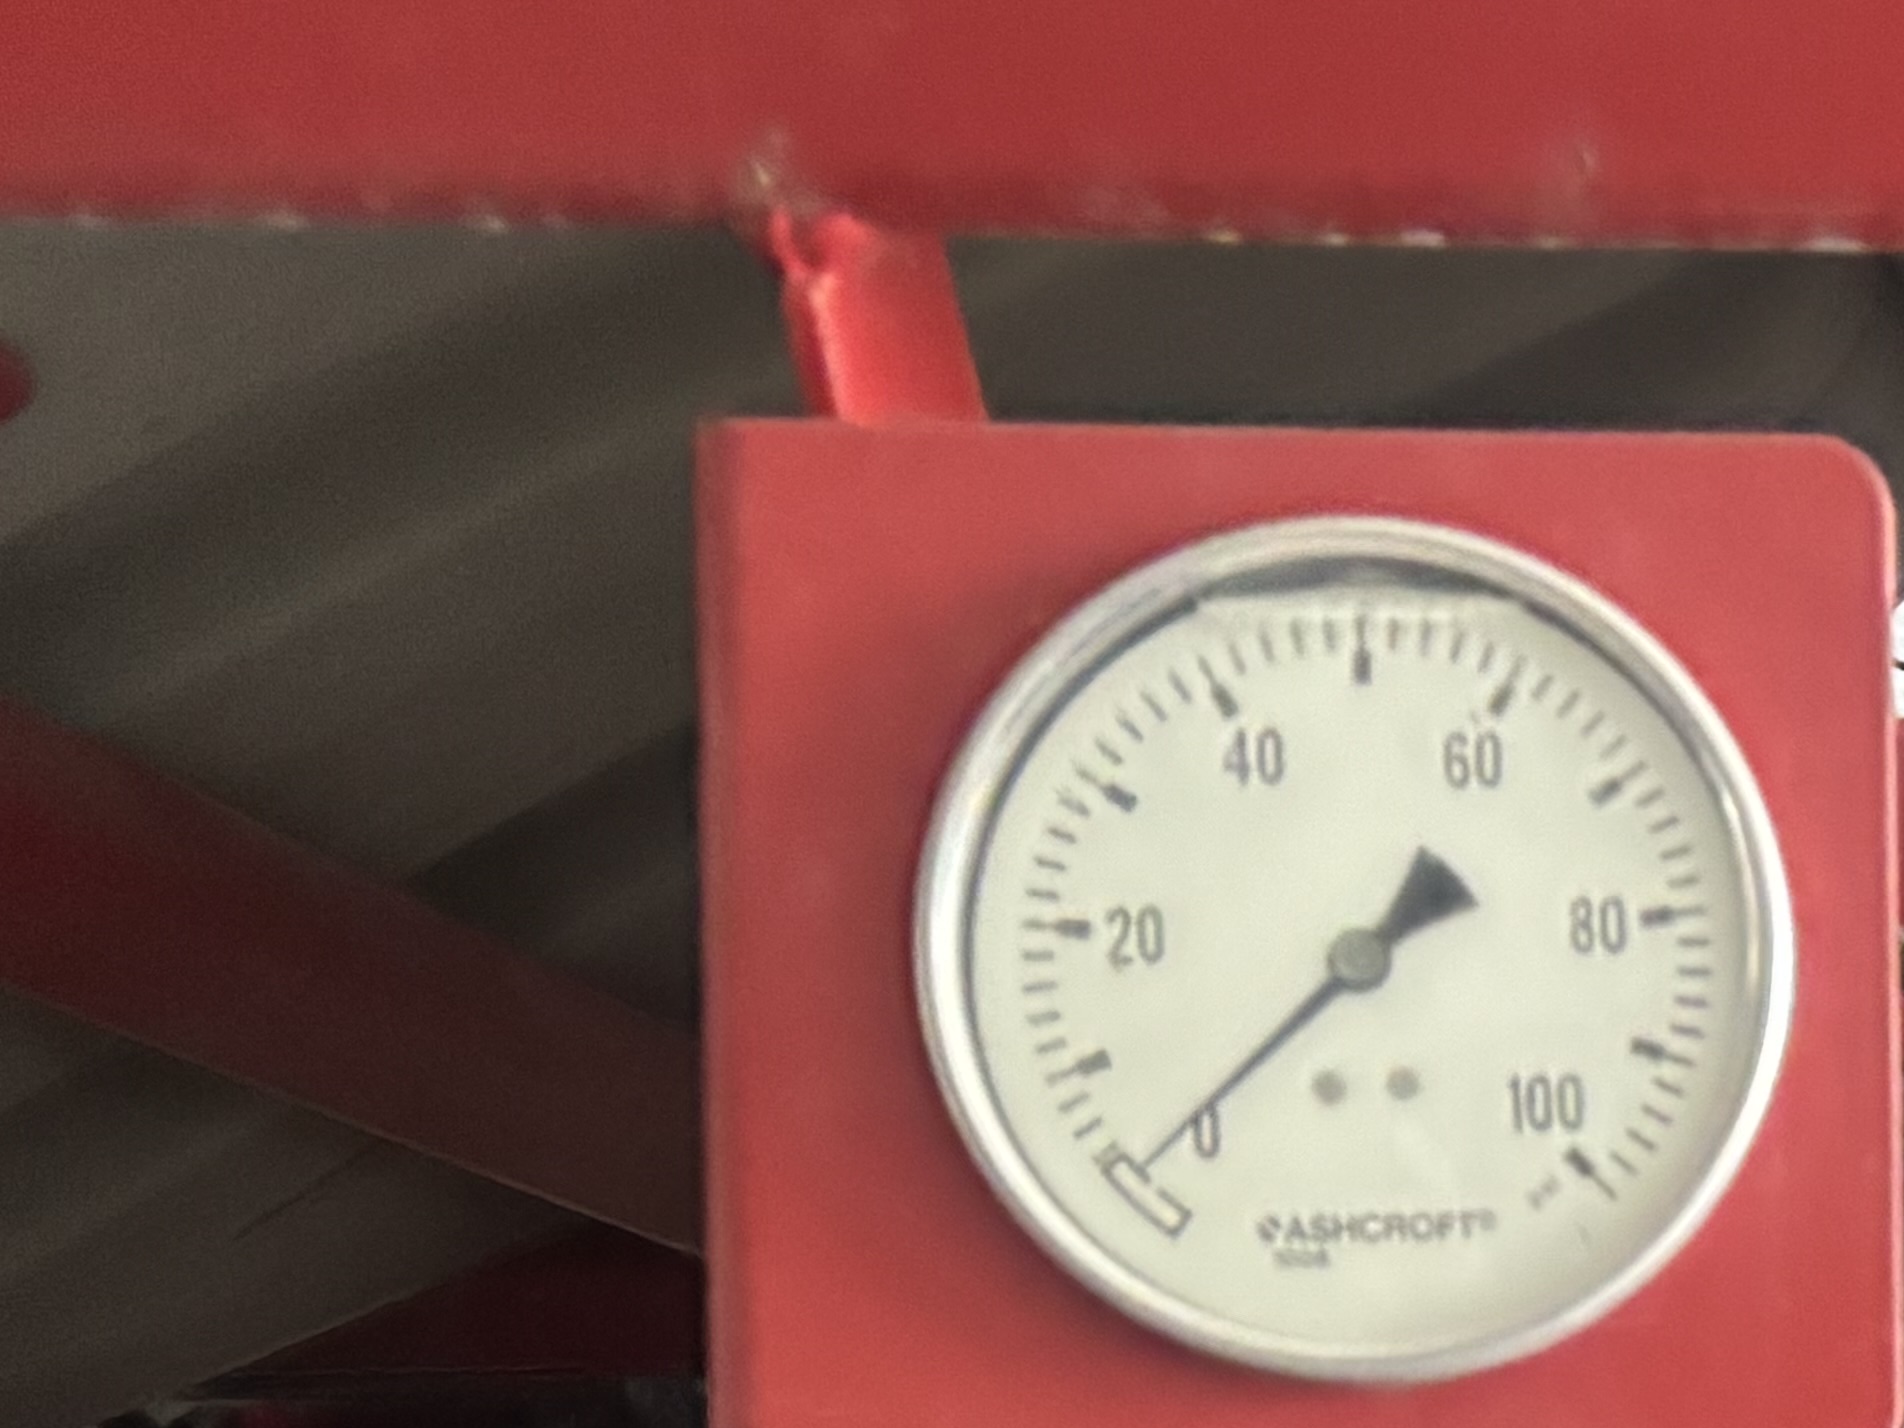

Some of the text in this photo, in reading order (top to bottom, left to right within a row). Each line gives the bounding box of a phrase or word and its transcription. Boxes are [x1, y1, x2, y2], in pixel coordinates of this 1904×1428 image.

[1222, 728, 1287, 787] 40
[1442, 729, 1504, 790] 60
[1105, 904, 1167, 965] 20
[1569, 895, 1629, 956] 80
[1193, 1103, 1221, 1160] 0
[1506, 1072, 1586, 1134] 100
